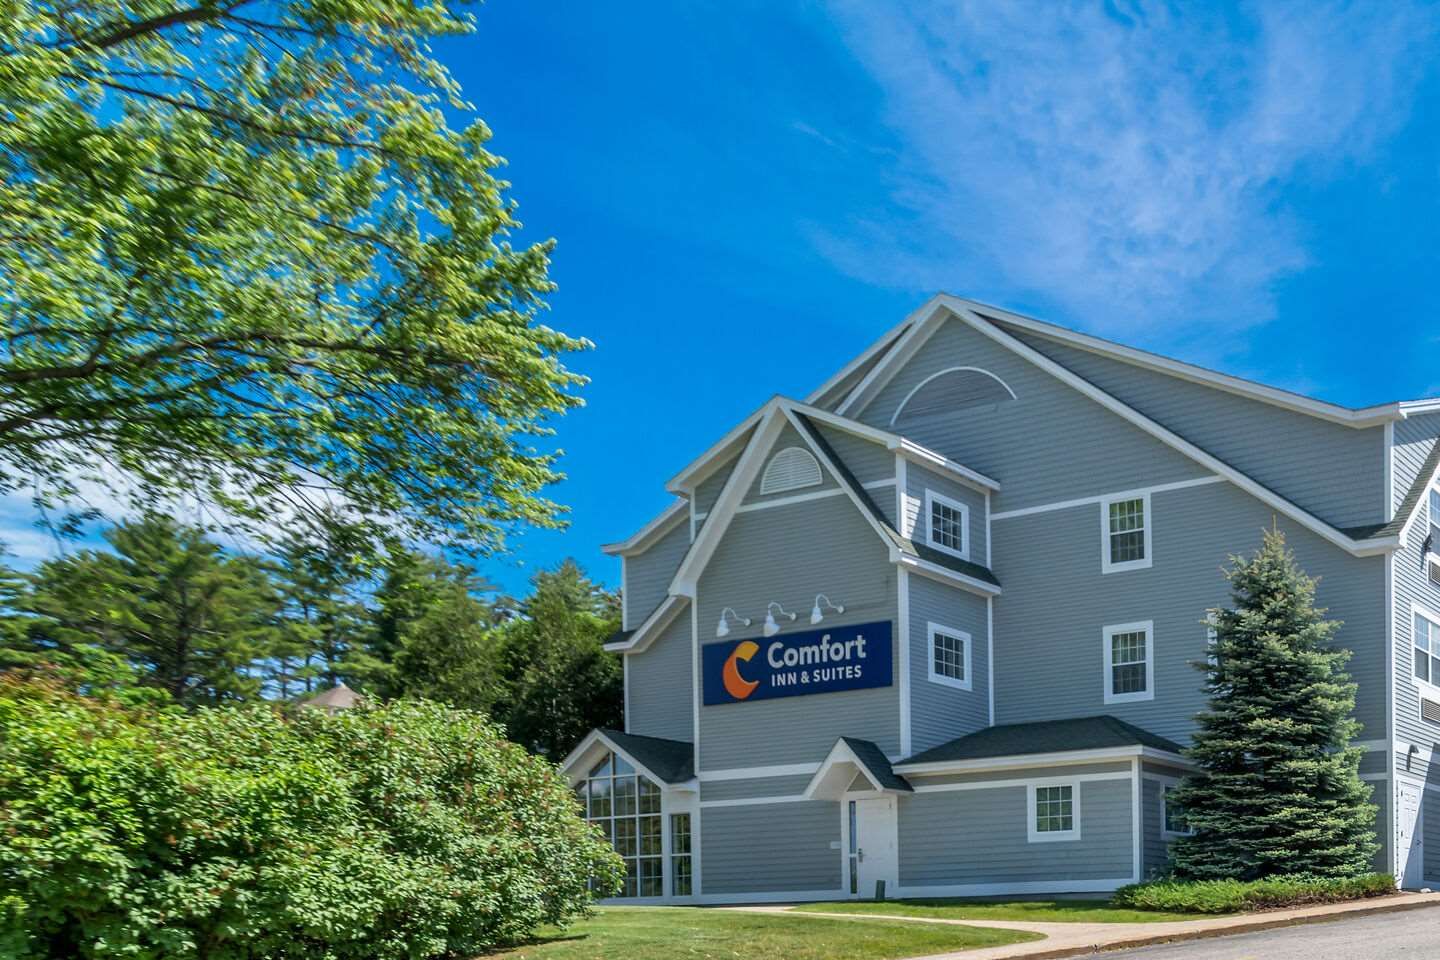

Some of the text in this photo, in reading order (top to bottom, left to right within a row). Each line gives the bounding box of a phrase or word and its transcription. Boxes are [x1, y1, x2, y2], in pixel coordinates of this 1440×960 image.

[767, 634, 867, 668] Comfort
[771, 665, 862, 687] INN & SUITES
